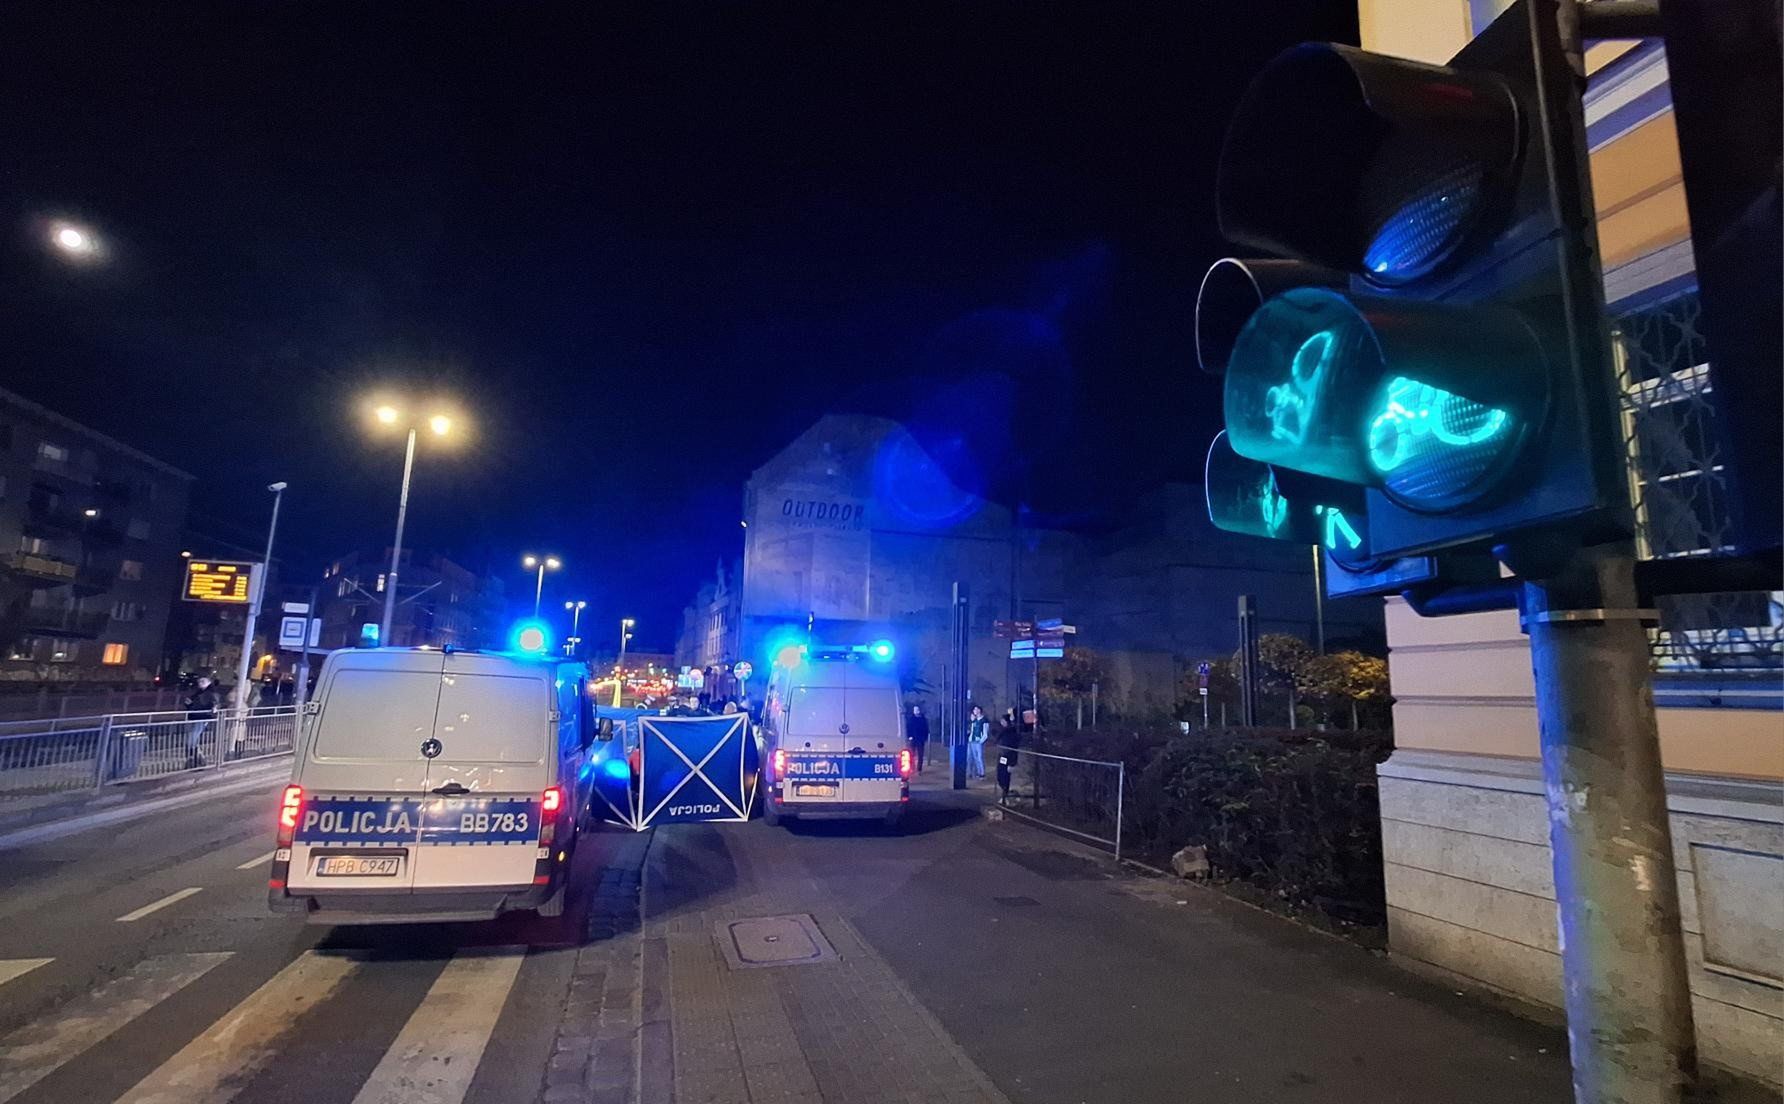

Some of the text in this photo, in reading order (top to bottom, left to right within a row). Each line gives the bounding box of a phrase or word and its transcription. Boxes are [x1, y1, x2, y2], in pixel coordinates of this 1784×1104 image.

[782, 499, 864, 523] OUTDOOR
[787, 762, 840, 774] POLICJA
[874, 764, 893, 773] B131
[669, 804, 720, 816] POLICJA
[303, 811, 411, 833] POLICJA
[327, 860, 394, 873] HPB C947
